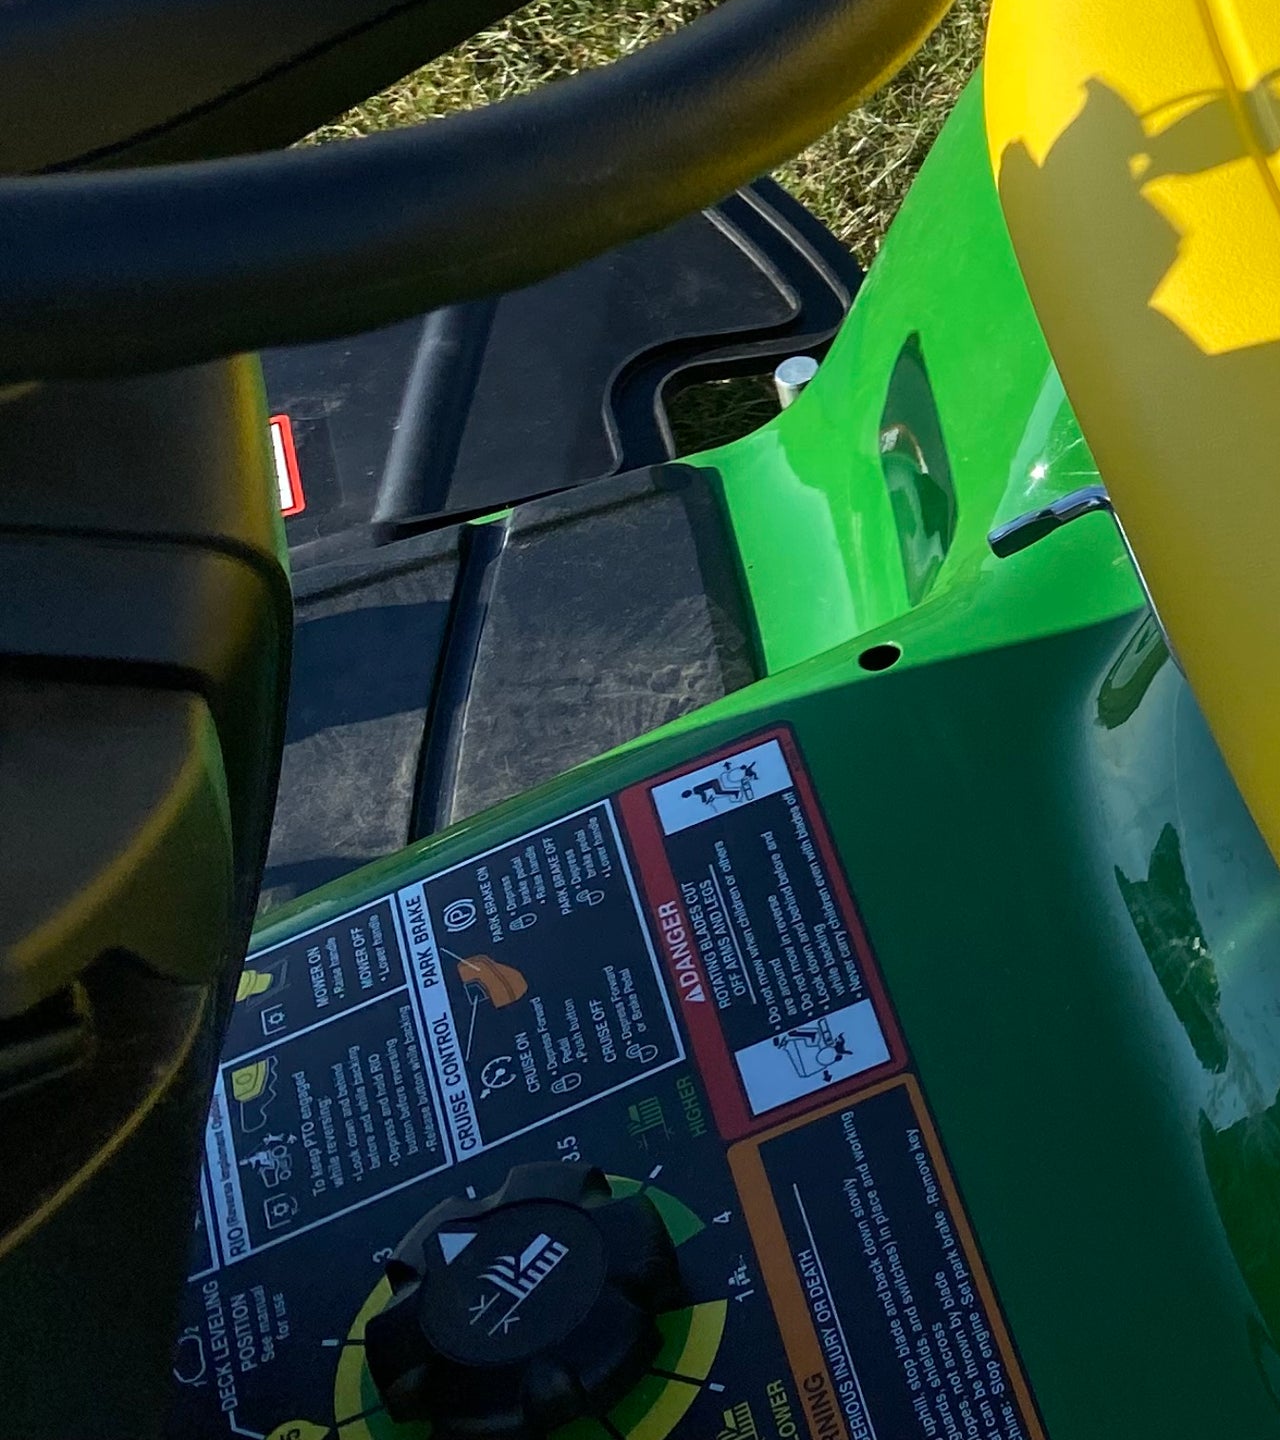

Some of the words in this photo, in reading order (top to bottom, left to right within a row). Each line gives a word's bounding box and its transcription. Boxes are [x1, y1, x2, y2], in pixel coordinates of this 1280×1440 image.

[781, 791, 797, 806] off
[587, 816, 604, 847] handle
[789, 805, 809, 840] blades
[541, 837, 557, 855] OFF
[573, 828, 592, 853] pedal
[714, 840, 732, 873] others
[760, 830, 778, 851] and
[799, 838, 816, 863] with
[476, 865, 489, 882] ON
[509, 855, 528, 880] pedal
[524, 845, 541, 876] handle
[547, 854, 566, 889] BRAKE
[564, 848, 582, 885] Depress
[582, 853, 597, 880] brake
[596, 845, 612, 874] Lower
[771, 852, 790, 888] before
[809, 861, 825, 888] even
[501, 875, 518, 912] Depress
[517, 879, 532, 906] brake
[533, 873, 547, 900] Raise
[680, 881, 699, 905] CUT
[698, 879, 719, 912] LEGS
[724, 874, 736, 886] or
[479, 880, 498, 916] BRAKE
[555, 887, 573, 916] PARK
[728, 885, 750, 928] children
[767, 894, 788, 934] reverse
[779, 885, 802, 924] behind
[818, 887, 841, 930] children
[367, 914, 384, 947] handle
[405, 894, 430, 946] BRAKE
[487, 914, 505, 943] PARK
[688, 904, 714, 952] BLADES
[709, 910, 727, 935] AND
[791, 921, 810, 944] and
[325, 936, 340, 969] handle
[350, 927, 366, 948] OFF
[657, 900, 700, 988] DANGER
[717, 936, 739, 970] ARMS
[743, 927, 760, 959] when
[780, 933, 792, 947] in
[813, 923, 836, 968] backing
[832, 930, 851, 959] carry
[306, 946, 322, 964] ON
[354, 946, 374, 990] MOWER
[375, 946, 390, 976] Lower
[416, 946, 440, 989] PARK
[784, 946, 801, 973] mow
[802, 943, 820, 975] down
[309, 963, 329, 1008] MOWER
[332, 966, 345, 995] Raise
[602, 965, 623, 1003] Forward
[618, 967, 635, 995] Pedal
[703, 950, 732, 1010] ROTATING
[728, 972, 747, 997] OFF
[752, 958, 770, 986] mow
[767, 957, 792, 997] around
[792, 972, 808, 993] not
[827, 966, 846, 997] while
[843, 959, 863, 993] Never
[759, 985, 776, 1006] not
[800, 992, 814, 1012] Do
[811, 973, 831, 1005] Look
[529, 996, 548, 1034] Forward
[564, 998, 580, 1032] button
[588, 999, 606, 1022] OFF
[614, 1001, 633, 1041] Depress
[627, 993, 643, 1021] Brake
[768, 1006, 782, 1025] Do
[784, 997, 798, 1016] are
[399, 1004, 415, 1045] backing
[636, 1022, 647, 1033] or
[431, 1011, 462, 1087] CONTROL
[514, 1031, 530, 1051] ON
[541, 1032, 559, 1071] Depress
[557, 1036, 574, 1064] Pedal
[570, 1030, 588, 1059] Push
[595, 1020, 617, 1063] CRUISE
[348, 1045, 364, 1086] backing
[367, 1053, 383, 1074] RIO
[385, 1037, 404, 1086] reversing
[406, 1044, 421, 1072] while
[519, 1049, 541, 1093] CRUISE
[291, 1070, 314, 1120] engaged
[330, 1062, 349, 1099] behind
[371, 1072, 387, 1098] hold
[413, 1071, 429, 1107] button
[338, 1096, 353, 1119] and
[354, 1085, 369, 1113] while
[376, 1096, 392, 1117] and
[395, 1085, 411, 1121] before
[675, 1074, 708, 1139] HIGHER
[300, 1121, 318, 1149] PTO
[317, 1095, 338, 1155] reversing:
[344, 1119, 358, 1148] down
[359, 1113, 375, 1134] and
[420, 1105, 438, 1148] Release
[449, 1089, 477, 1151] CRUISE
[366, 1134, 381, 1171] before
[383, 1117, 402, 1163] Depress
[403, 1119, 419, 1156] button
[556, 1135, 581, 1162] 3.5
[840, 1110, 865, 1163] working
[905, 1128, 922, 1152] key
[308, 1147, 324, 1179] keep
[327, 1155, 344, 1189] while
[347, 1148, 364, 1177] Look
[855, 1162, 874, 1188] and
[311, 1178, 327, 1197] To
[842, 1178, 865, 1219] slowly
[712, 1210, 732, 1224] 4
[866, 1189, 890, 1226] place
[226, 1226, 247, 1258] RIO
[857, 1219, 878, 1256] down
[878, 1225, 892, 1242] in
[934, 1210, 955, 1250] brake
[372, 1248, 393, 1263] 3
[946, 1248, 969, 1280] park
[797, 1249, 825, 1299] DEATH
[868, 1256, 889, 1292] back
[881, 1241, 914, 1305] switches)
[272, 1292, 287, 1318] use
[734, 1289, 755, 1303] 1
[877, 1290, 898, 1317] and
[934, 1271, 955, 1310] blade
[202, 1279, 230, 1362] LEVELING
[249, 1284, 271, 1334] manual
[813, 1298, 832, 1323] OR
[903, 1305, 923, 1333] and
[948, 1311, 963, 1330] by
[229, 1292, 258, 1373] POSITION
[275, 1320, 290, 1340] for
[890, 1318, 911, 1359] blade
[931, 1321, 956, 1369] across
[969, 1311, 993, 1359] engine
[260, 1335, 276, 1363] See
[820, 1327, 850, 1381] INJURY
[916, 1332, 942, 1388] shields,
[955, 1329, 979, 1379] thrown
[214, 1361, 239, 1412] DECK
[903, 1358, 922, 1391] stop
[946, 1370, 964, 1395] not
[972, 1379, 987, 1401] be
[912, 1391, 937, 1437] uphill,
[979, 1400, 996, 1428] can
